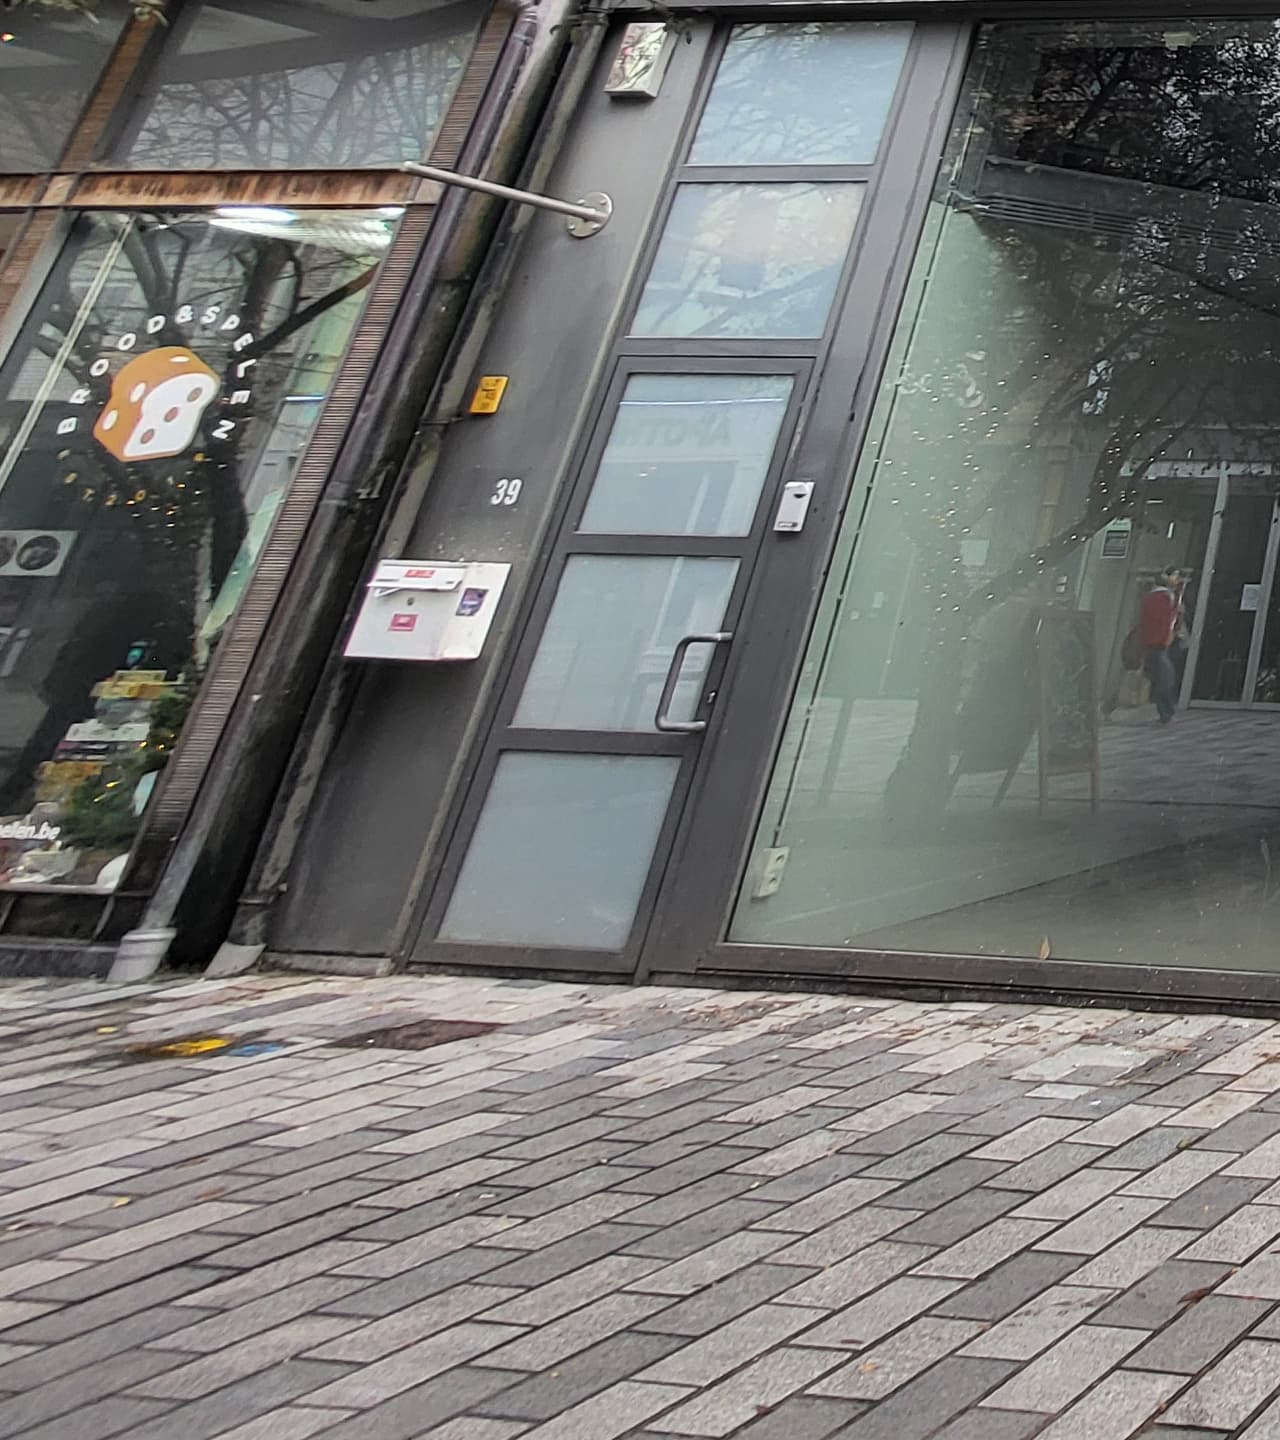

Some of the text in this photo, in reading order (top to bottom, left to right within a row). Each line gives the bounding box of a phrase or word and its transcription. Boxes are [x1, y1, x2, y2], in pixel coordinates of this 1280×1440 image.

[56, 304, 257, 441] BROOD & SPELEN
[491, 478, 522, 505] 39
